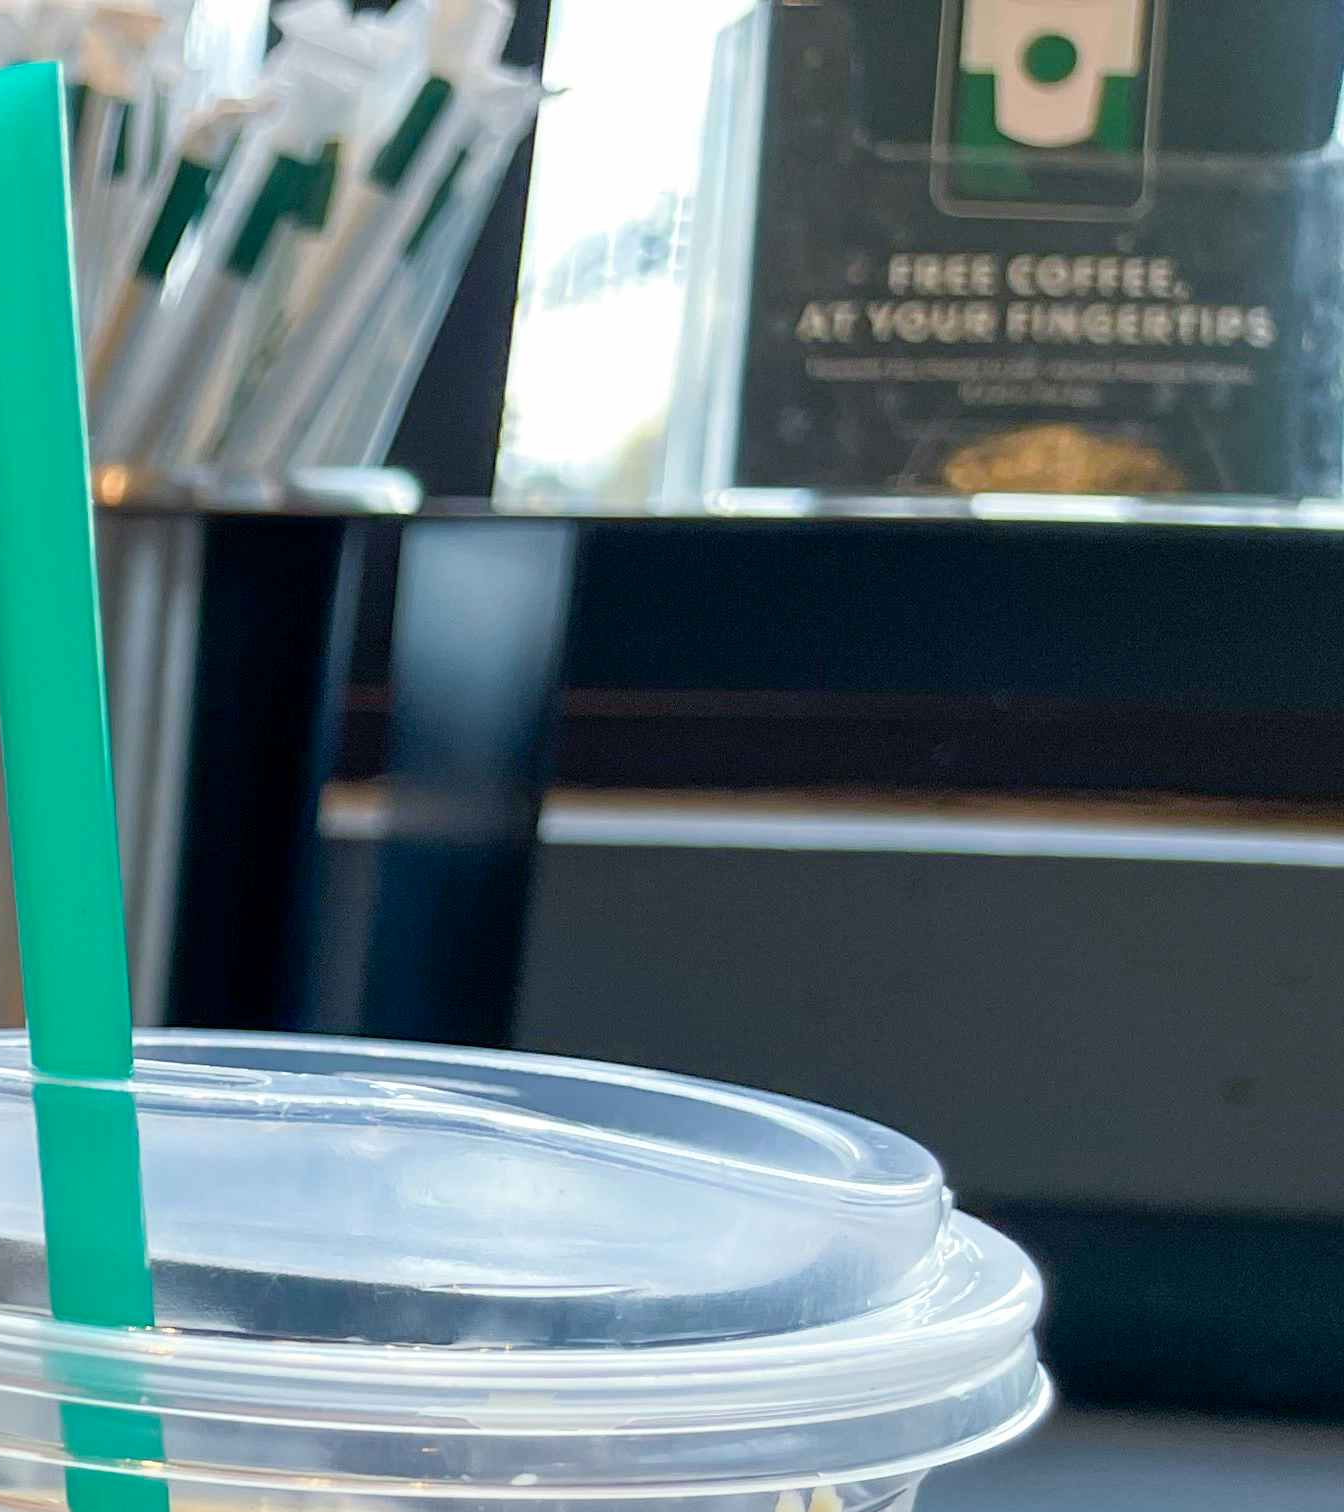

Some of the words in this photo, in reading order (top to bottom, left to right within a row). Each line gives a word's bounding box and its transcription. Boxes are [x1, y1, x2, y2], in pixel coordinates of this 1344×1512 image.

[889, 254, 997, 299] FREE
[795, 302, 854, 344] AT
[866, 302, 997, 344] YOUR
[1005, 303, 1275, 350] FINGERTIPS
